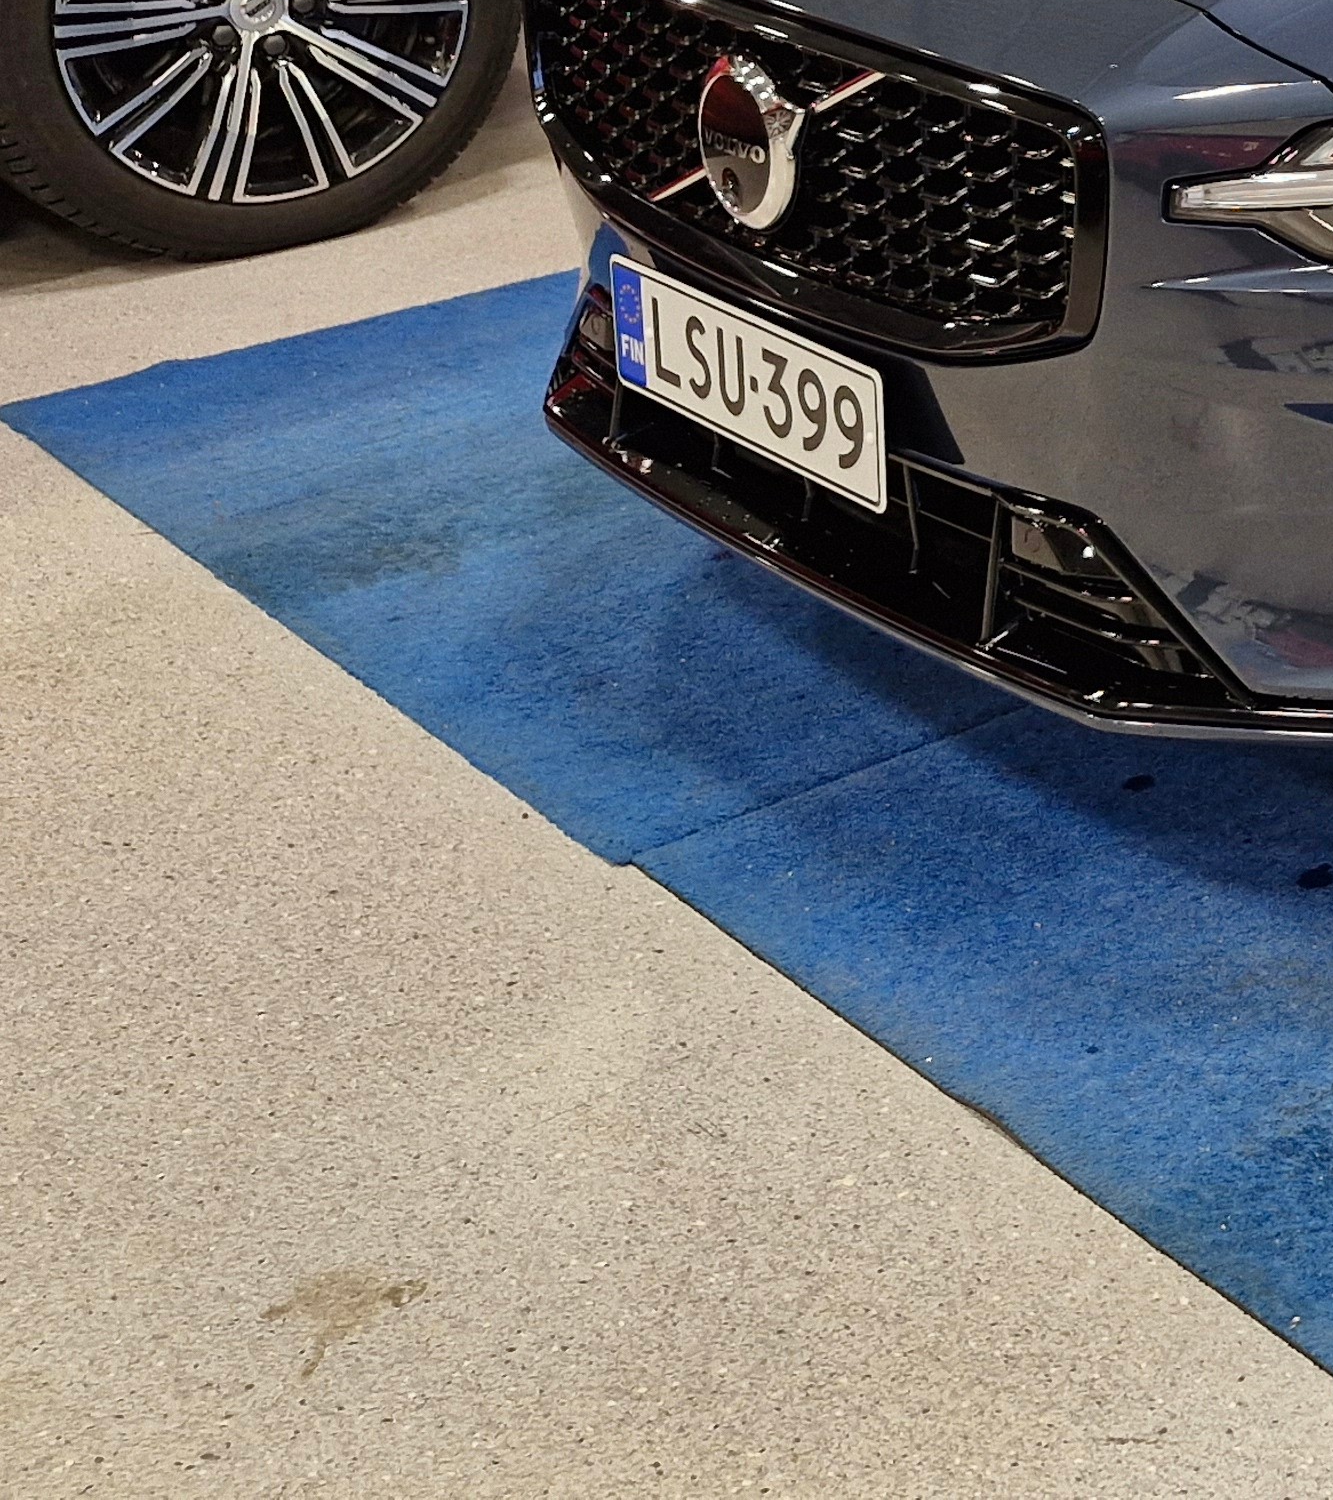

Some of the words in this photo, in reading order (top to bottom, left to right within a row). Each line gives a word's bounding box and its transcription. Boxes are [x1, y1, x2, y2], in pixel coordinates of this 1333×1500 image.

[703, 124, 766, 164] VOLVO
[620, 333, 645, 366] FIN
[651, 296, 864, 470] LSU-399
